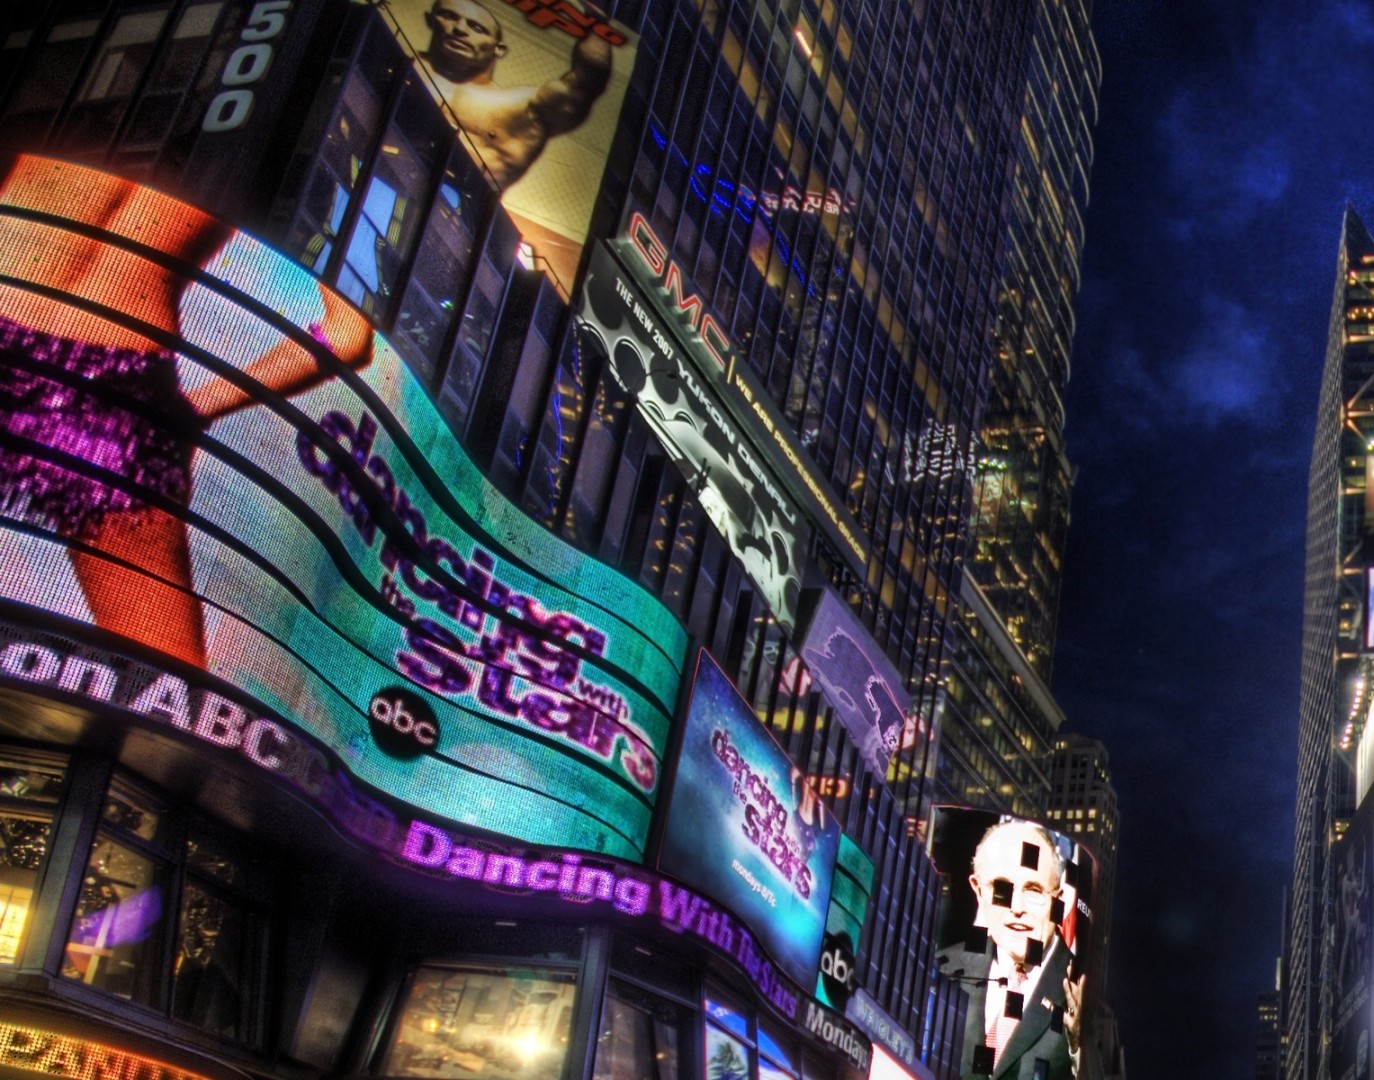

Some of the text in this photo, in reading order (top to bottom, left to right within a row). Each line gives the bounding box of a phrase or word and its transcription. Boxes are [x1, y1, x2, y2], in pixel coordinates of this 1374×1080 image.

[203, 0, 289, 133] 500
[615, 277, 796, 526] THE NEW 2007 YUKON DENALI
[629, 212, 730, 370] GMC
[735, 373, 753, 403] WE
[752, 401, 774, 433] ARE
[773, 429, 838, 524] PROFESSIONAL
[297, 410, 608, 690] dancing
[370, 694, 439, 746] abc
[712, 729, 788, 836] dancing
[0, 641, 118, 701] on
[129, 672, 289, 771] ABC
[402, 819, 650, 917] Dancing
[659, 880, 734, 953] With
[759, 960, 797, 1018] Stars
[805, 1002, 868, 1070] Mondays
